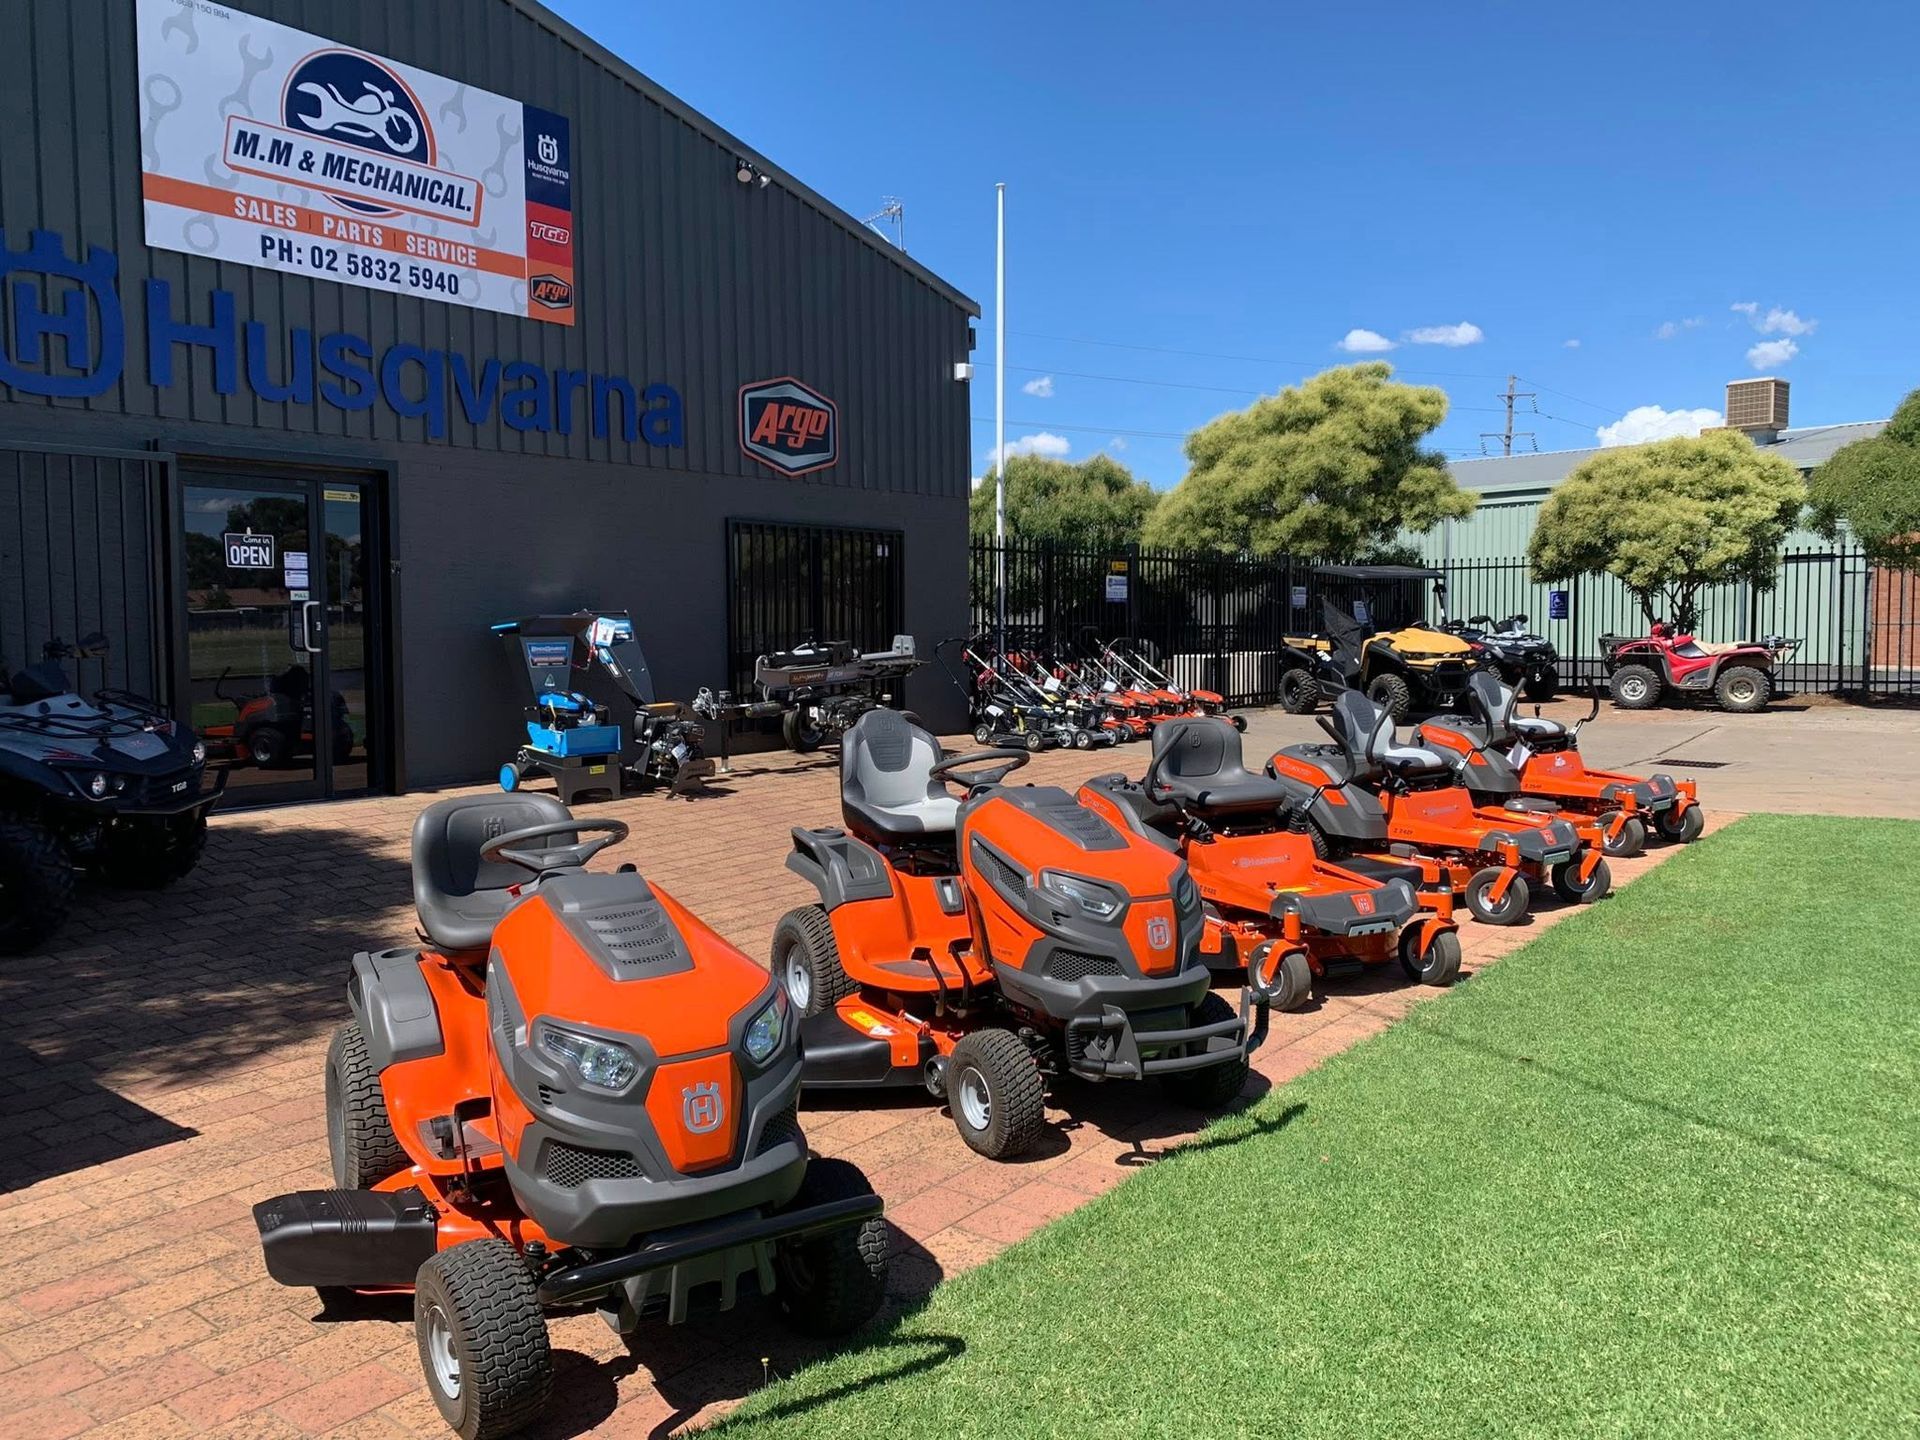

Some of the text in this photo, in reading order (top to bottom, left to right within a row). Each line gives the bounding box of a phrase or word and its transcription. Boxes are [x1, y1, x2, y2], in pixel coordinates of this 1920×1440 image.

[233, 129, 472, 212] M.M & MECHANICAL.
[527, 159, 569, 180] Husqvarna
[234, 196, 477, 267] SALES PARTS SERVICE
[530, 220, 570, 244] TGB
[260, 234, 459, 296] PH: 02 5832 5940
[534, 282, 569, 301] Argo
[146, 277, 684, 449] Husqvarna
[750, 402, 829, 449] Argo
[230, 545, 271, 566] OPEN
